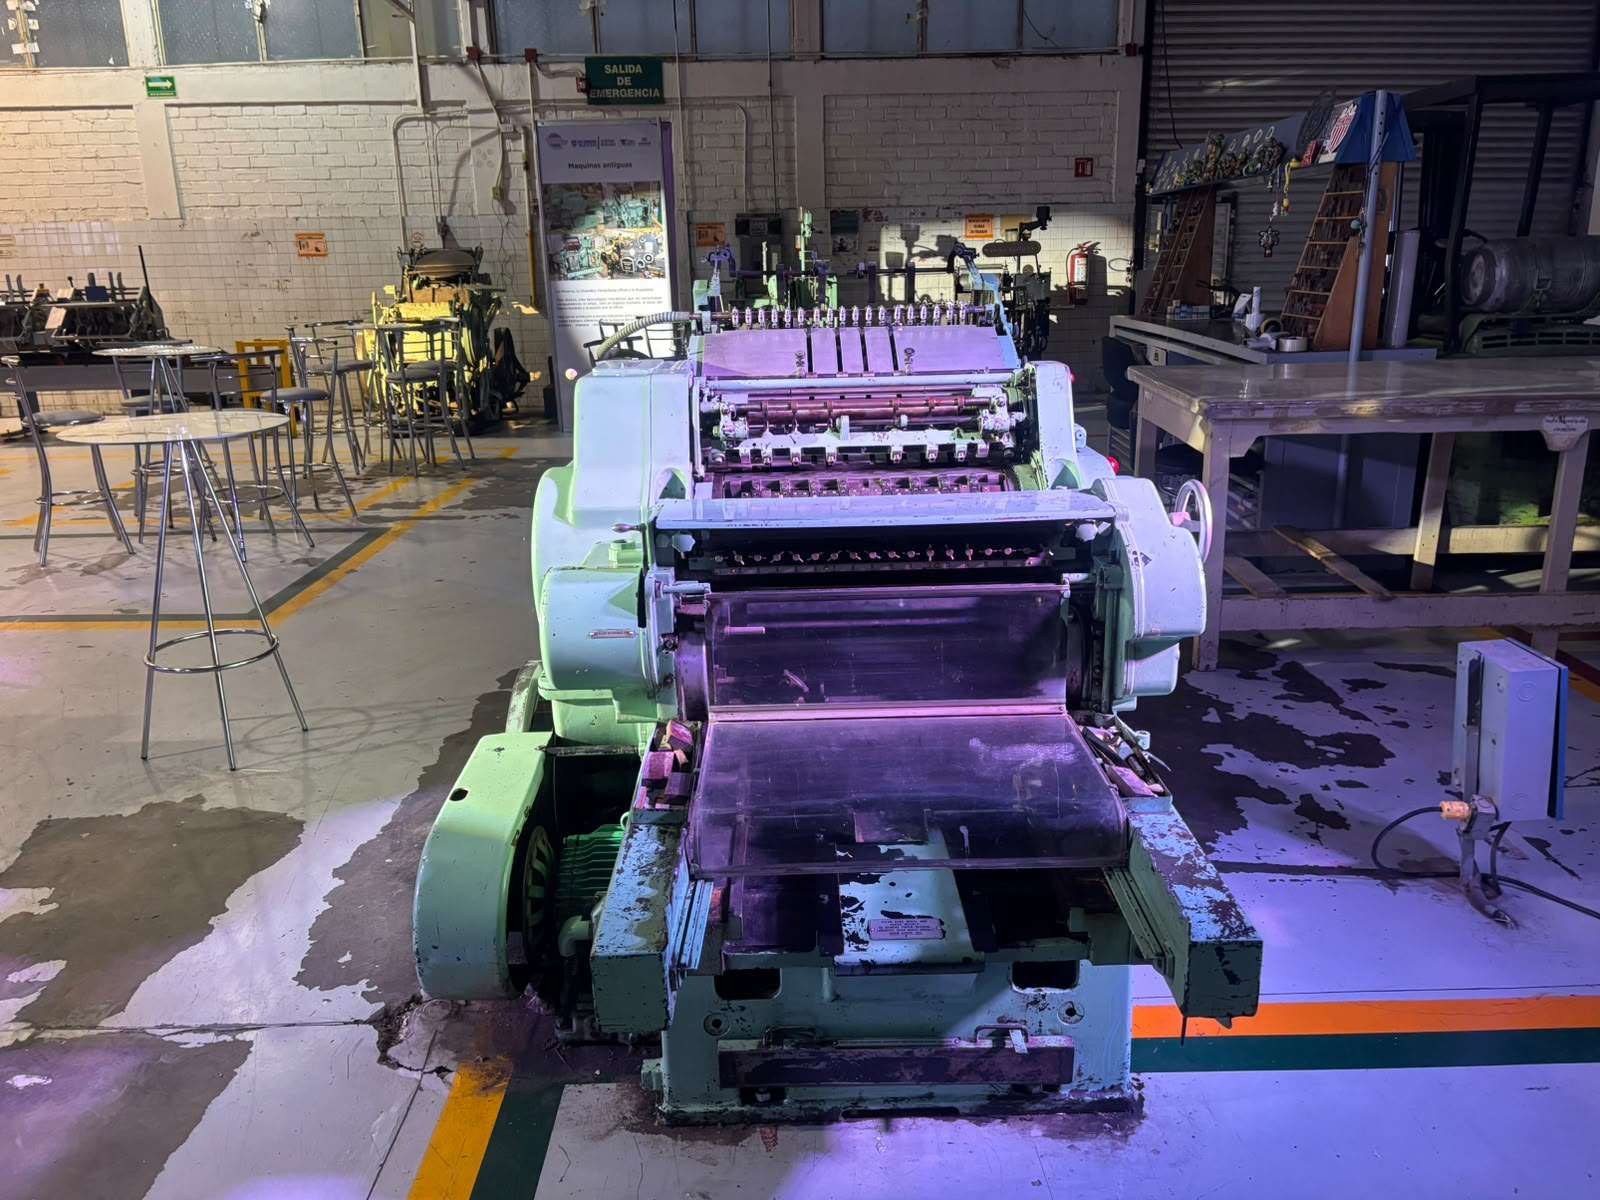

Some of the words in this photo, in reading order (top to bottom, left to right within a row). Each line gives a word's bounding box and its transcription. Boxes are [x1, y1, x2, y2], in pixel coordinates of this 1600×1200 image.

[604, 64, 642, 74] SALIDA
[616, 76, 632, 86] DE
[603, 161, 632, 170] antiguas
